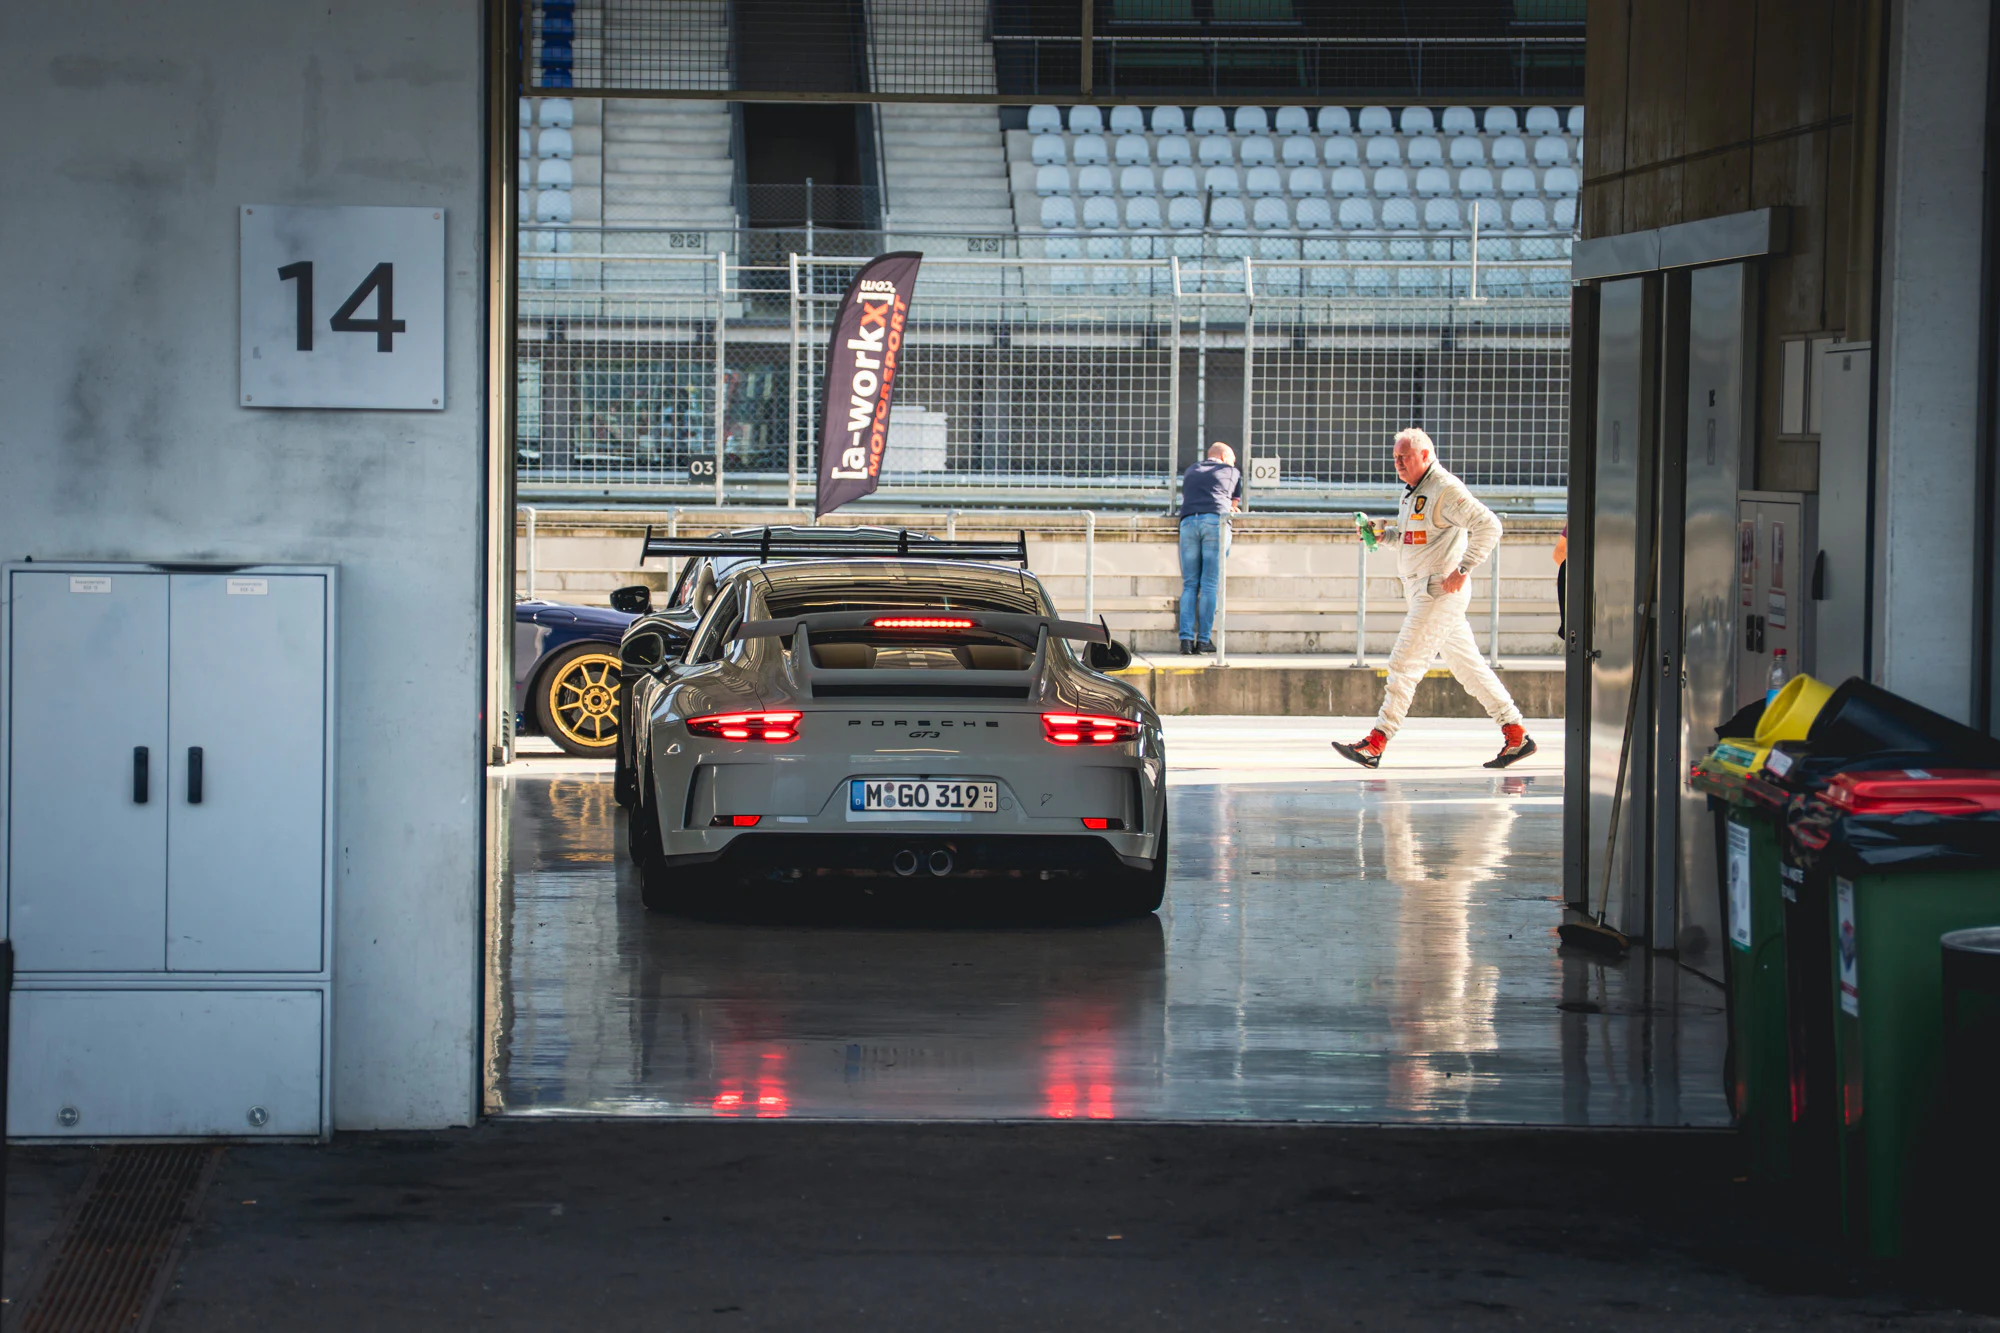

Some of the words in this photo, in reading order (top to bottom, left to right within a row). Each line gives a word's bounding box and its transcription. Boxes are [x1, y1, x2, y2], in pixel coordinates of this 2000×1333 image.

[277, 261, 406, 353] 14
[868, 294, 906, 475] MOTORSPORT
[690, 460, 714, 476] 03
[1255, 465, 1277, 479] 02
[848, 720, 999, 728] PORSCHE
[908, 731, 941, 739] GT3
[866, 784, 882, 807] M
[898, 783, 930, 808] GO
[935, 784, 980, 808] 319
[983, 785, 994, 793] 04
[984, 801, 994, 809] 10
